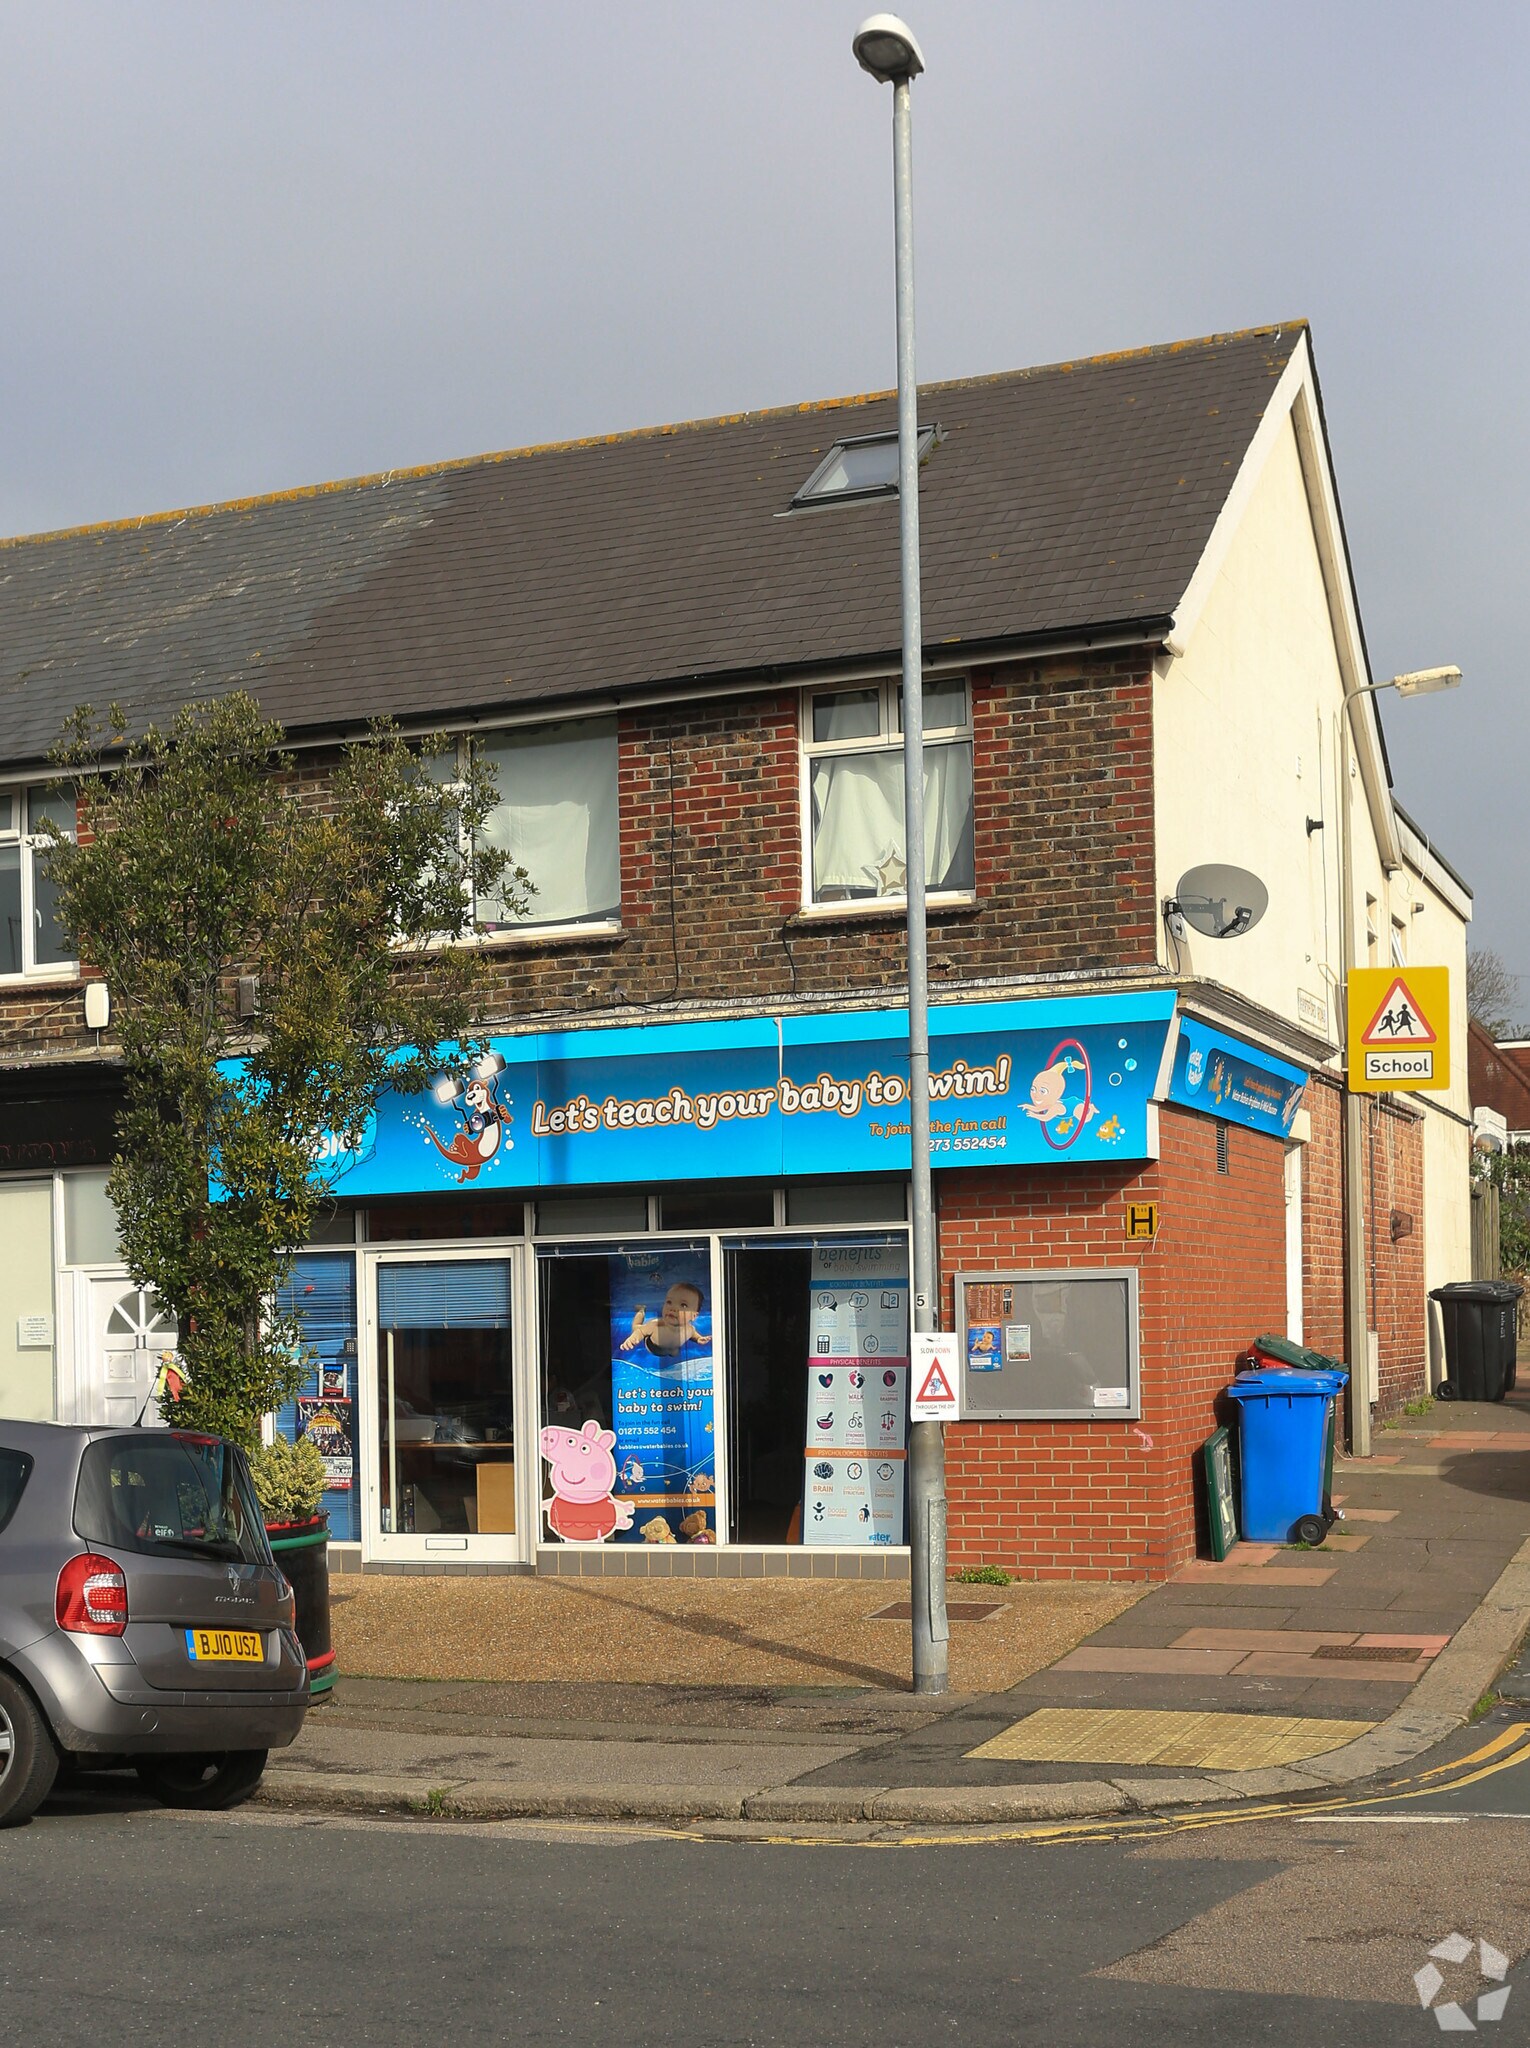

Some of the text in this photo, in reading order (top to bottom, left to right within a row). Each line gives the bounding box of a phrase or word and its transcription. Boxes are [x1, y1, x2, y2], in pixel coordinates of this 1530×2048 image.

[1370, 1058, 1429, 1073] School
[532, 1056, 1010, 1135] Let's teach your baby to wim!
[870, 1116, 1008, 1139] To join the fun call
[953, 1136, 1008, 1151] 552454
[1131, 1206, 1153, 1235] H
[819, 1248, 882, 1264] benefits
[857, 1261, 900, 1271] swimming
[855, 1297, 864, 1305] 17
[891, 1297, 896, 1305] 2
[916, 1295, 925, 1306] 5
[618, 1388, 647, 1399] Let's
[649, 1387, 684, 1398] teach
[618, 1400, 702, 1415] baby to swim!
[314, 1426, 337, 1434] ZYAIR
[618, 1426, 676, 1436] 01273 552 454
[869, 1532, 890, 1541] water
[200, 1633, 258, 1657] BJ10 USZ
